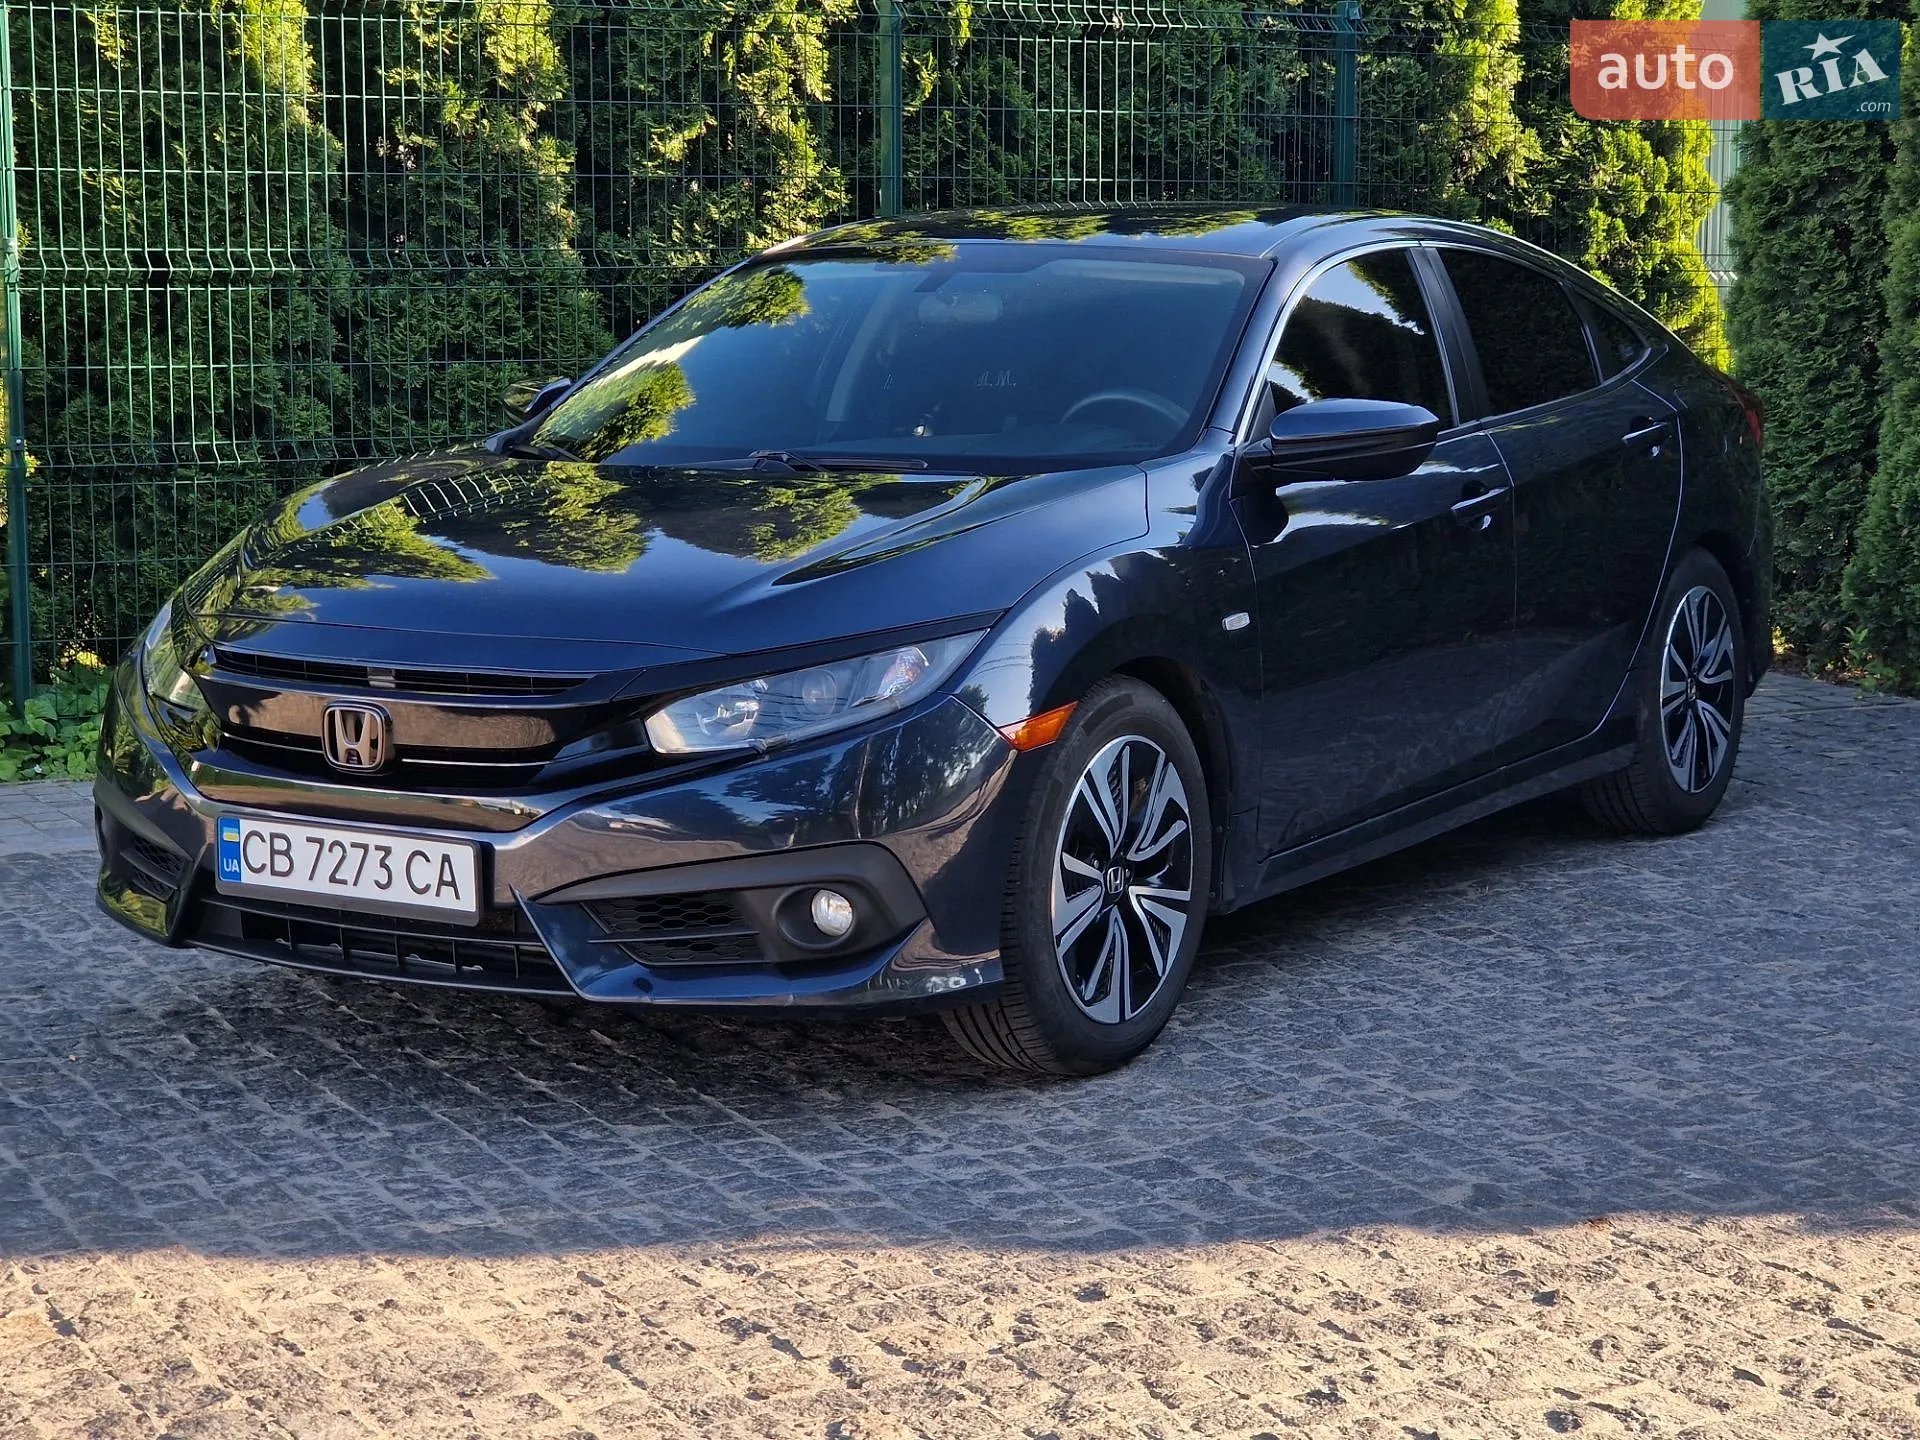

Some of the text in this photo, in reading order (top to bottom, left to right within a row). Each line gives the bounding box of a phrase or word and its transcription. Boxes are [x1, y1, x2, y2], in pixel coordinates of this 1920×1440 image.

[224, 857, 240, 873] UA
[242, 829, 461, 900] CB 7273 CA
